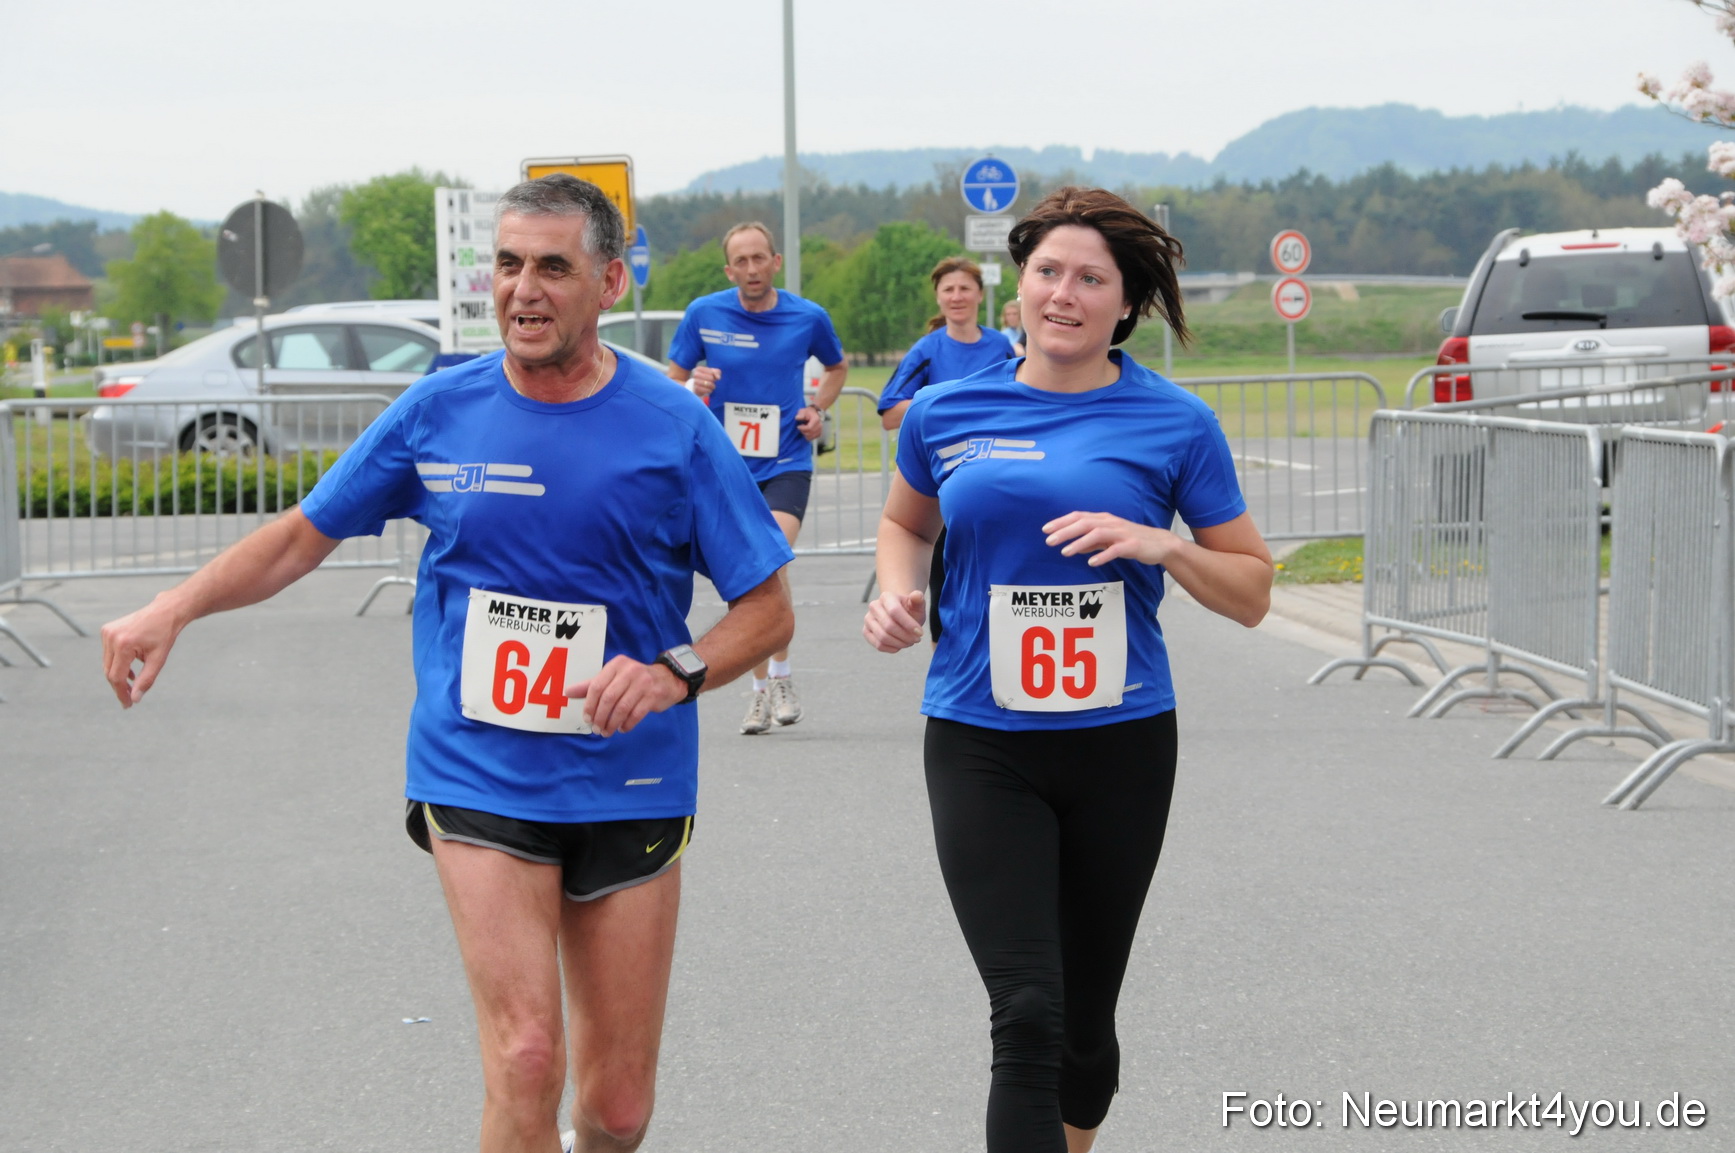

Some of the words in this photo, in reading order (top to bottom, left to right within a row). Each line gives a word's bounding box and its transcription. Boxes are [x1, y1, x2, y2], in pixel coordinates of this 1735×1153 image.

[1282, 243, 1302, 262] 60
[1577, 340, 1599, 350] KIA
[739, 421, 760, 451] 71
[1011, 591, 1074, 606] MEYER
[488, 599, 551, 623] MEYER
[1011, 607, 1075, 618] WERBUNG
[488, 614, 551, 635] WERBUNG
[1021, 626, 1097, 699] 65
[492, 640, 569, 719] 64
